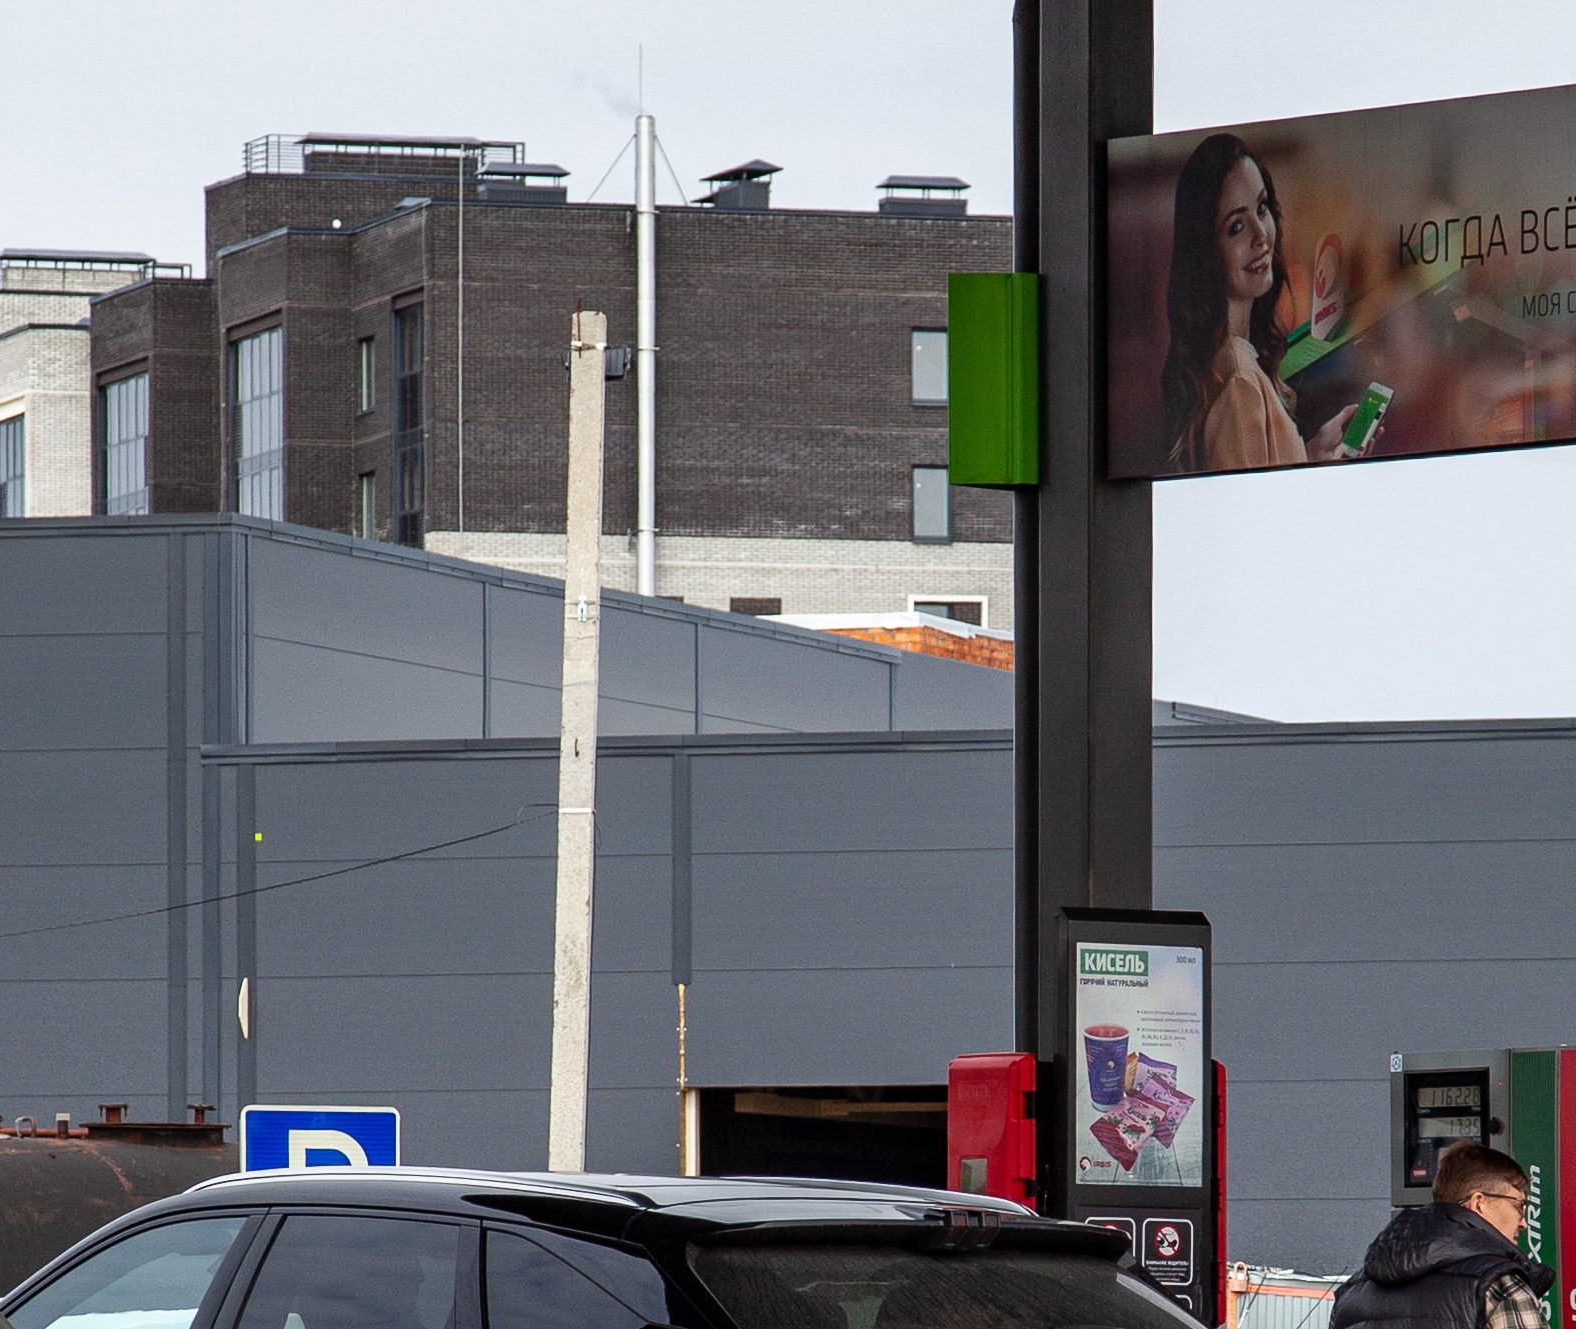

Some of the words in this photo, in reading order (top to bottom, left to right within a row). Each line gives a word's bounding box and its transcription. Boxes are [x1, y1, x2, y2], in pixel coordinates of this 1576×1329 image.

[1398, 213, 1508, 269] КОГДА
[1522, 292, 1561, 318] МОЯ
[1085, 952, 1145, 973] КИСЕЛЬ
[1527, 1164, 1542, 1264] XTRim
